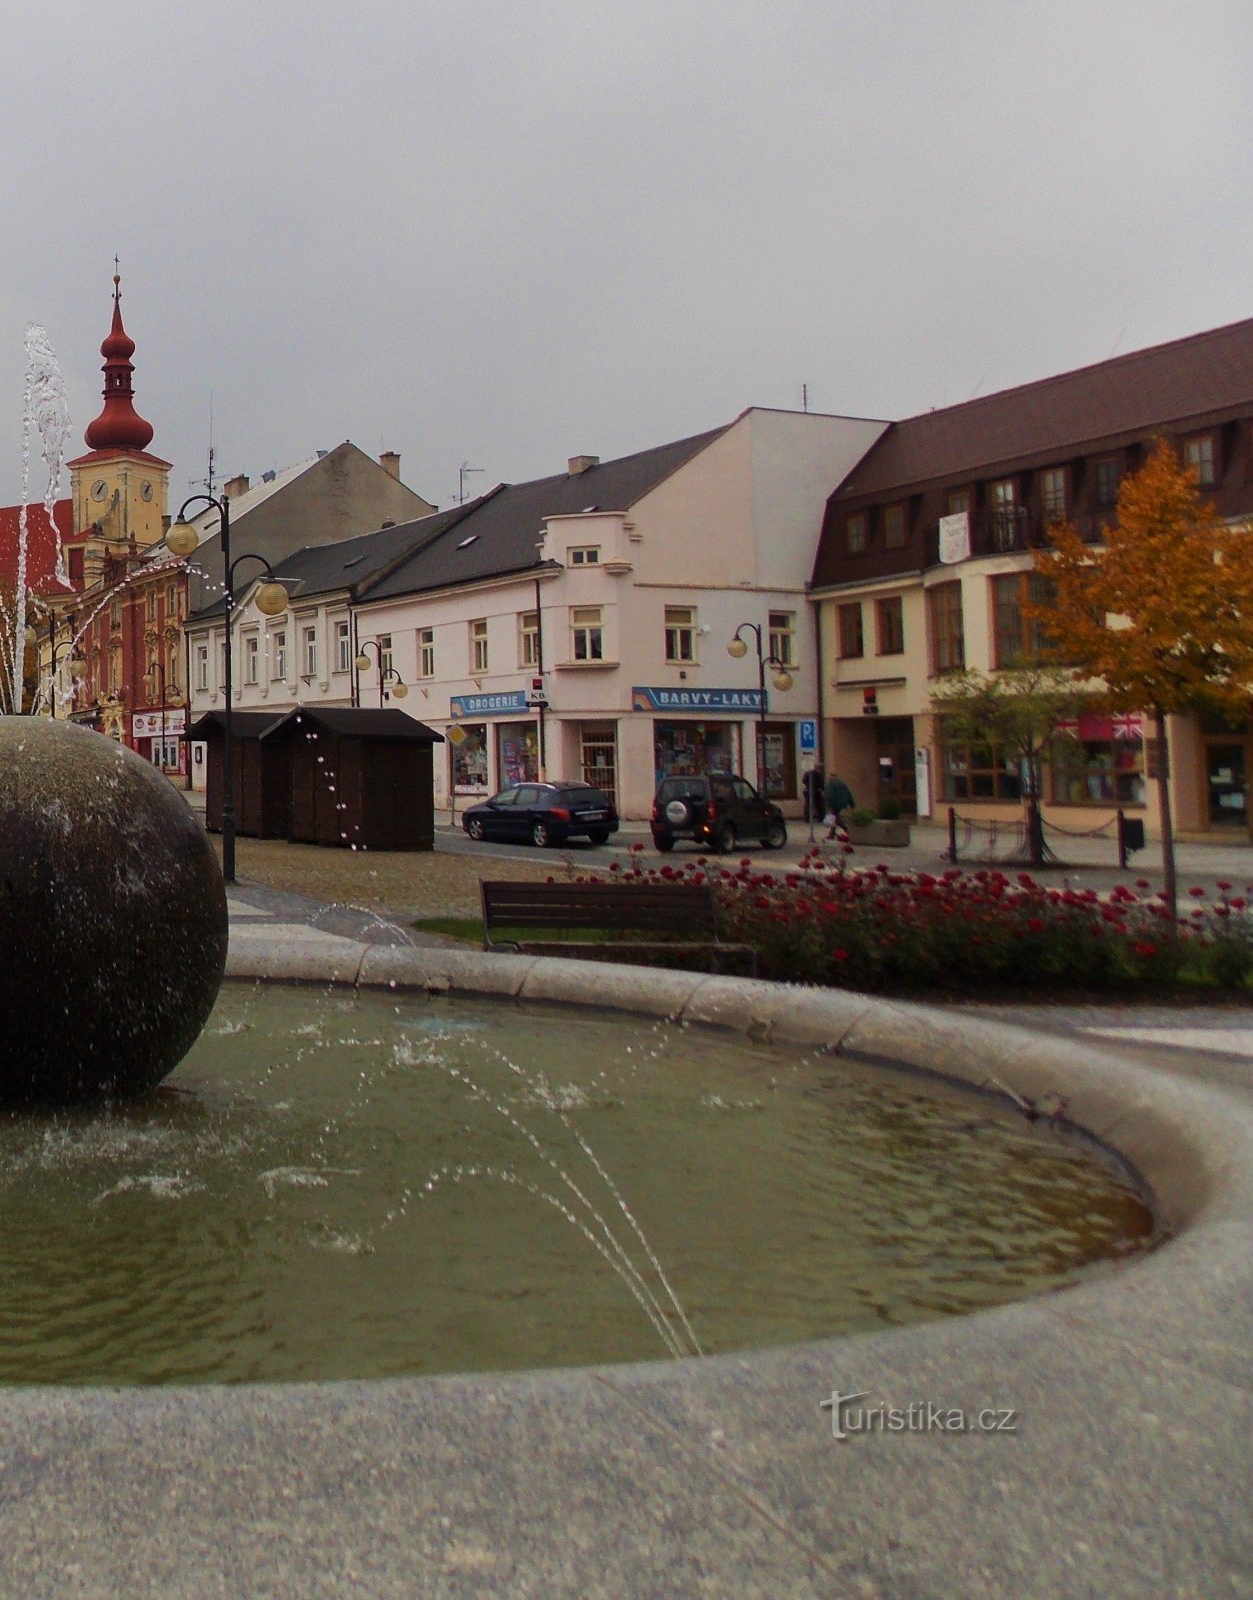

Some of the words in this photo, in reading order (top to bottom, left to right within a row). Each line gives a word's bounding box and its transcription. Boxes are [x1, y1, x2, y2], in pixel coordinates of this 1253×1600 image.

[469, 696, 519, 710] DROGERIE
[659, 692, 762, 705] BARVY-LAKY
[802, 723, 812, 740] P
